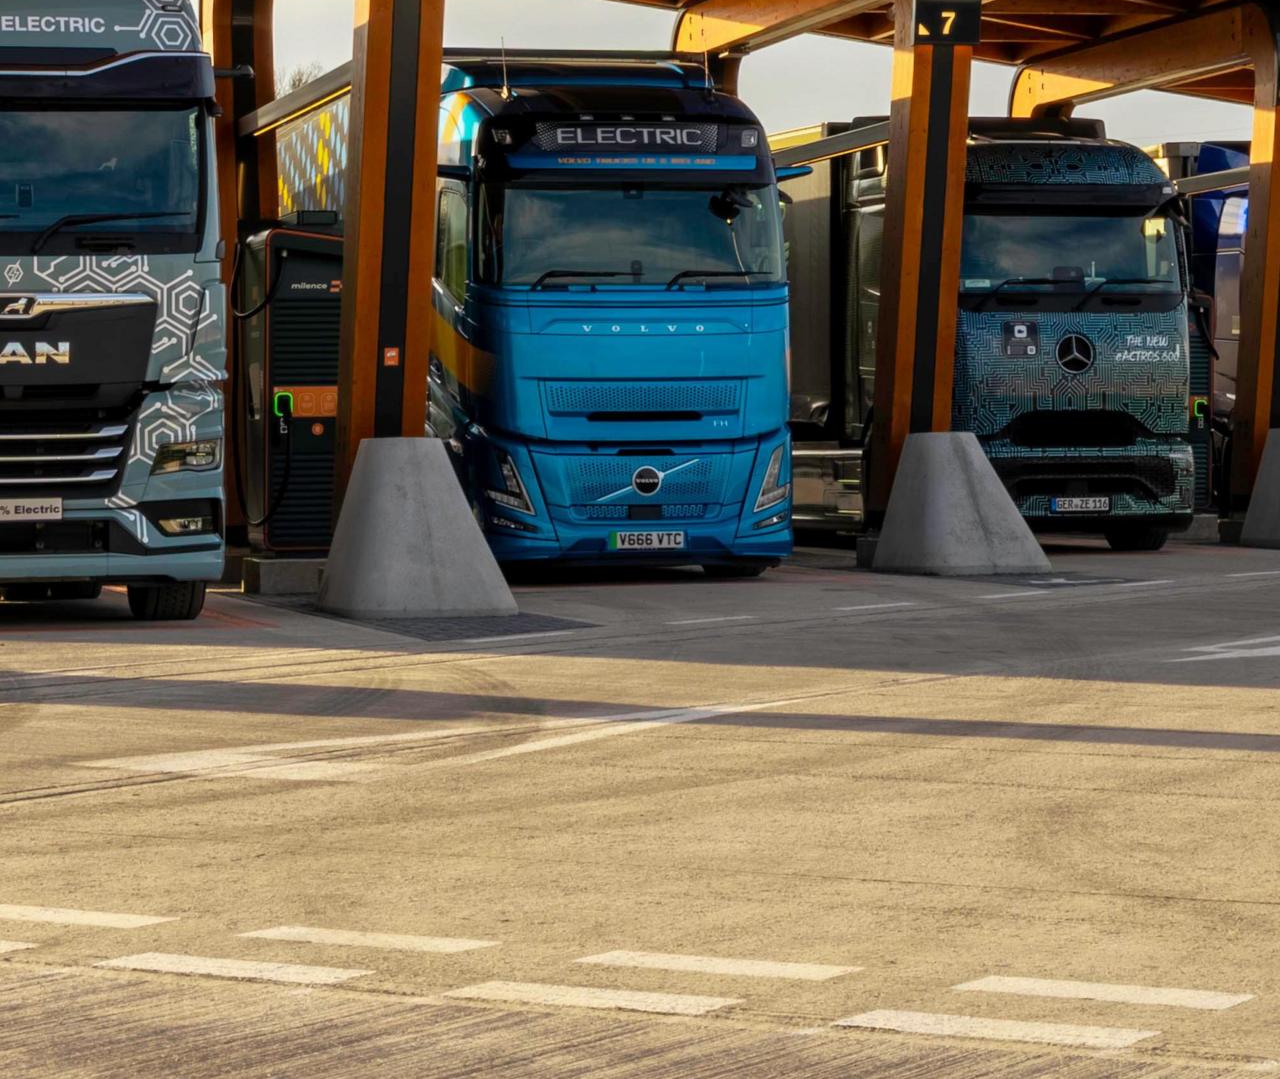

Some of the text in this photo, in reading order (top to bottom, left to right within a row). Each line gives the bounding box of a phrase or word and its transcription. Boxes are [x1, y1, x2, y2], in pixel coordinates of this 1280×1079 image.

[1, 15, 106, 33] ELECTRIC
[941, 11, 956, 35] 7
[556, 127, 703, 146] ELECTRIC
[0, 506, 10, 515] %
[14, 504, 60, 514] Electric
[619, 533, 682, 546] V666 VTC
